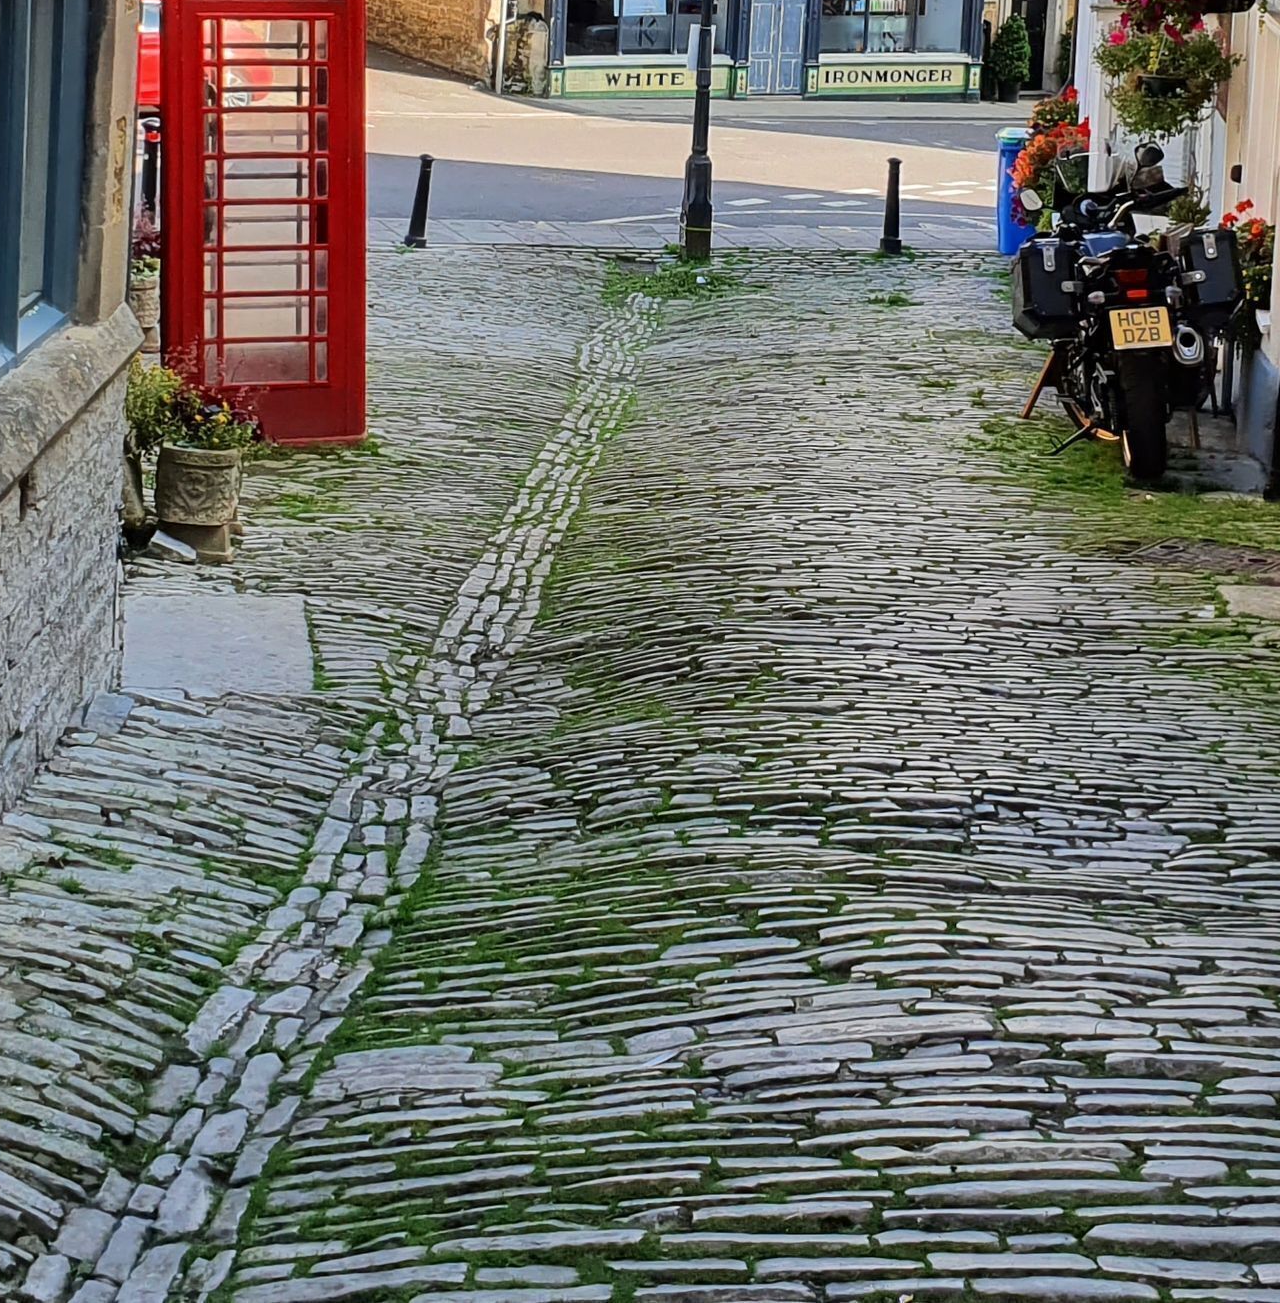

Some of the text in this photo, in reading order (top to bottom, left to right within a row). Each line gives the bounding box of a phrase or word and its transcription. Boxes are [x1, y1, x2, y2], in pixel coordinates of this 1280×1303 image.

[605, 72, 685, 87] WHITE
[824, 69, 953, 84] IRONMONGER
[1117, 310, 1161, 327] HC19
[1123, 327, 1161, 343] DZB
